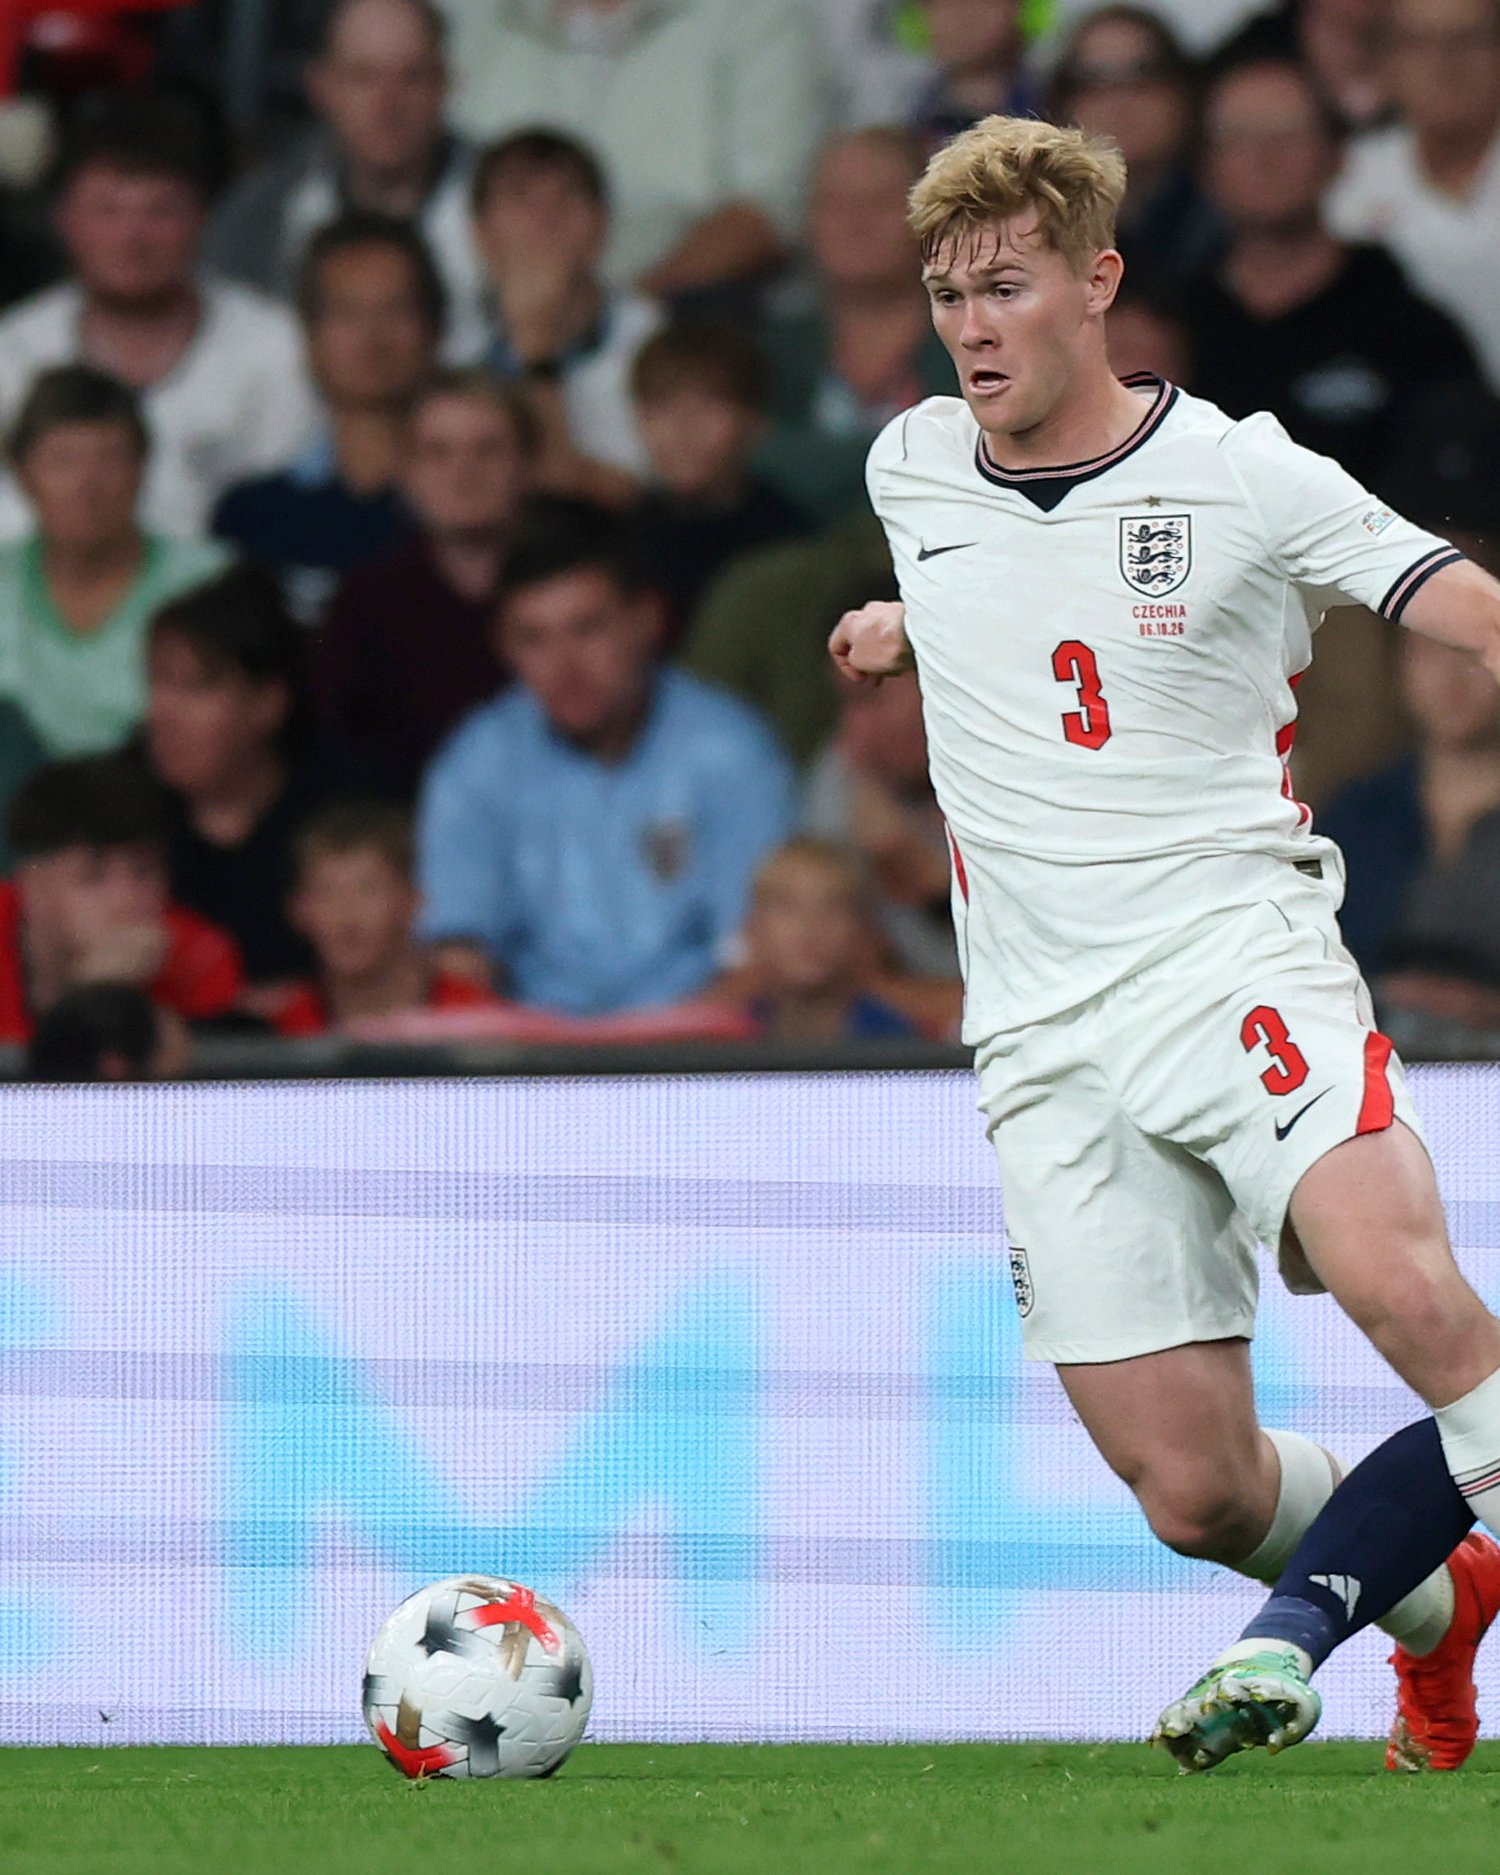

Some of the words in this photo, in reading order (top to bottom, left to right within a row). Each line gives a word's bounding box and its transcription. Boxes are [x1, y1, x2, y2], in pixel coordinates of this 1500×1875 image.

[1132, 604, 1187, 618] CZECHIA
[1139, 622, 1185, 636] 06.10.26
[1051, 639, 1112, 751] 3
[1239, 1005, 1310, 1096] 3
